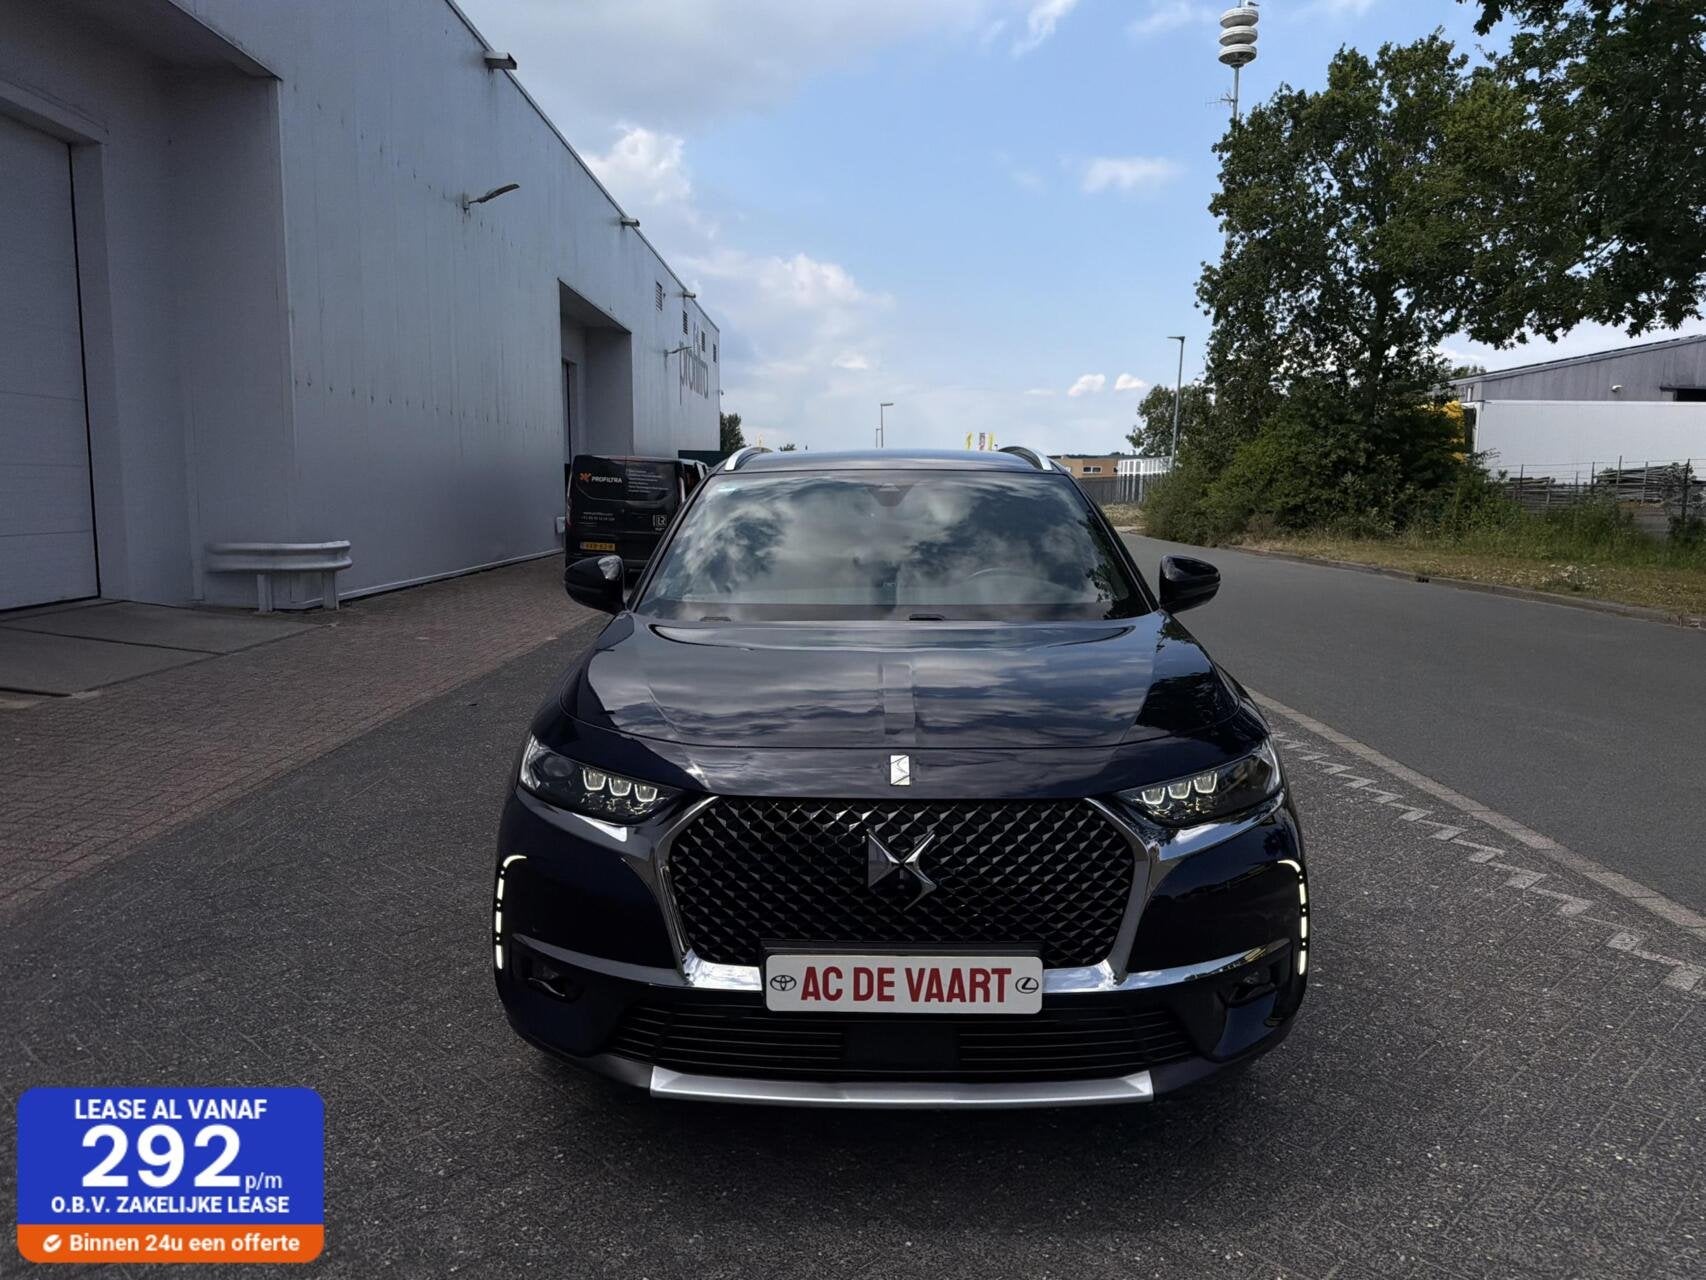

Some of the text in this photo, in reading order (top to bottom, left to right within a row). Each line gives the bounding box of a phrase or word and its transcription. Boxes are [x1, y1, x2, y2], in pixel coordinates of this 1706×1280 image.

[591, 475, 623, 484] PROFILTRA
[800, 966, 1012, 1003] AC DE VAART
